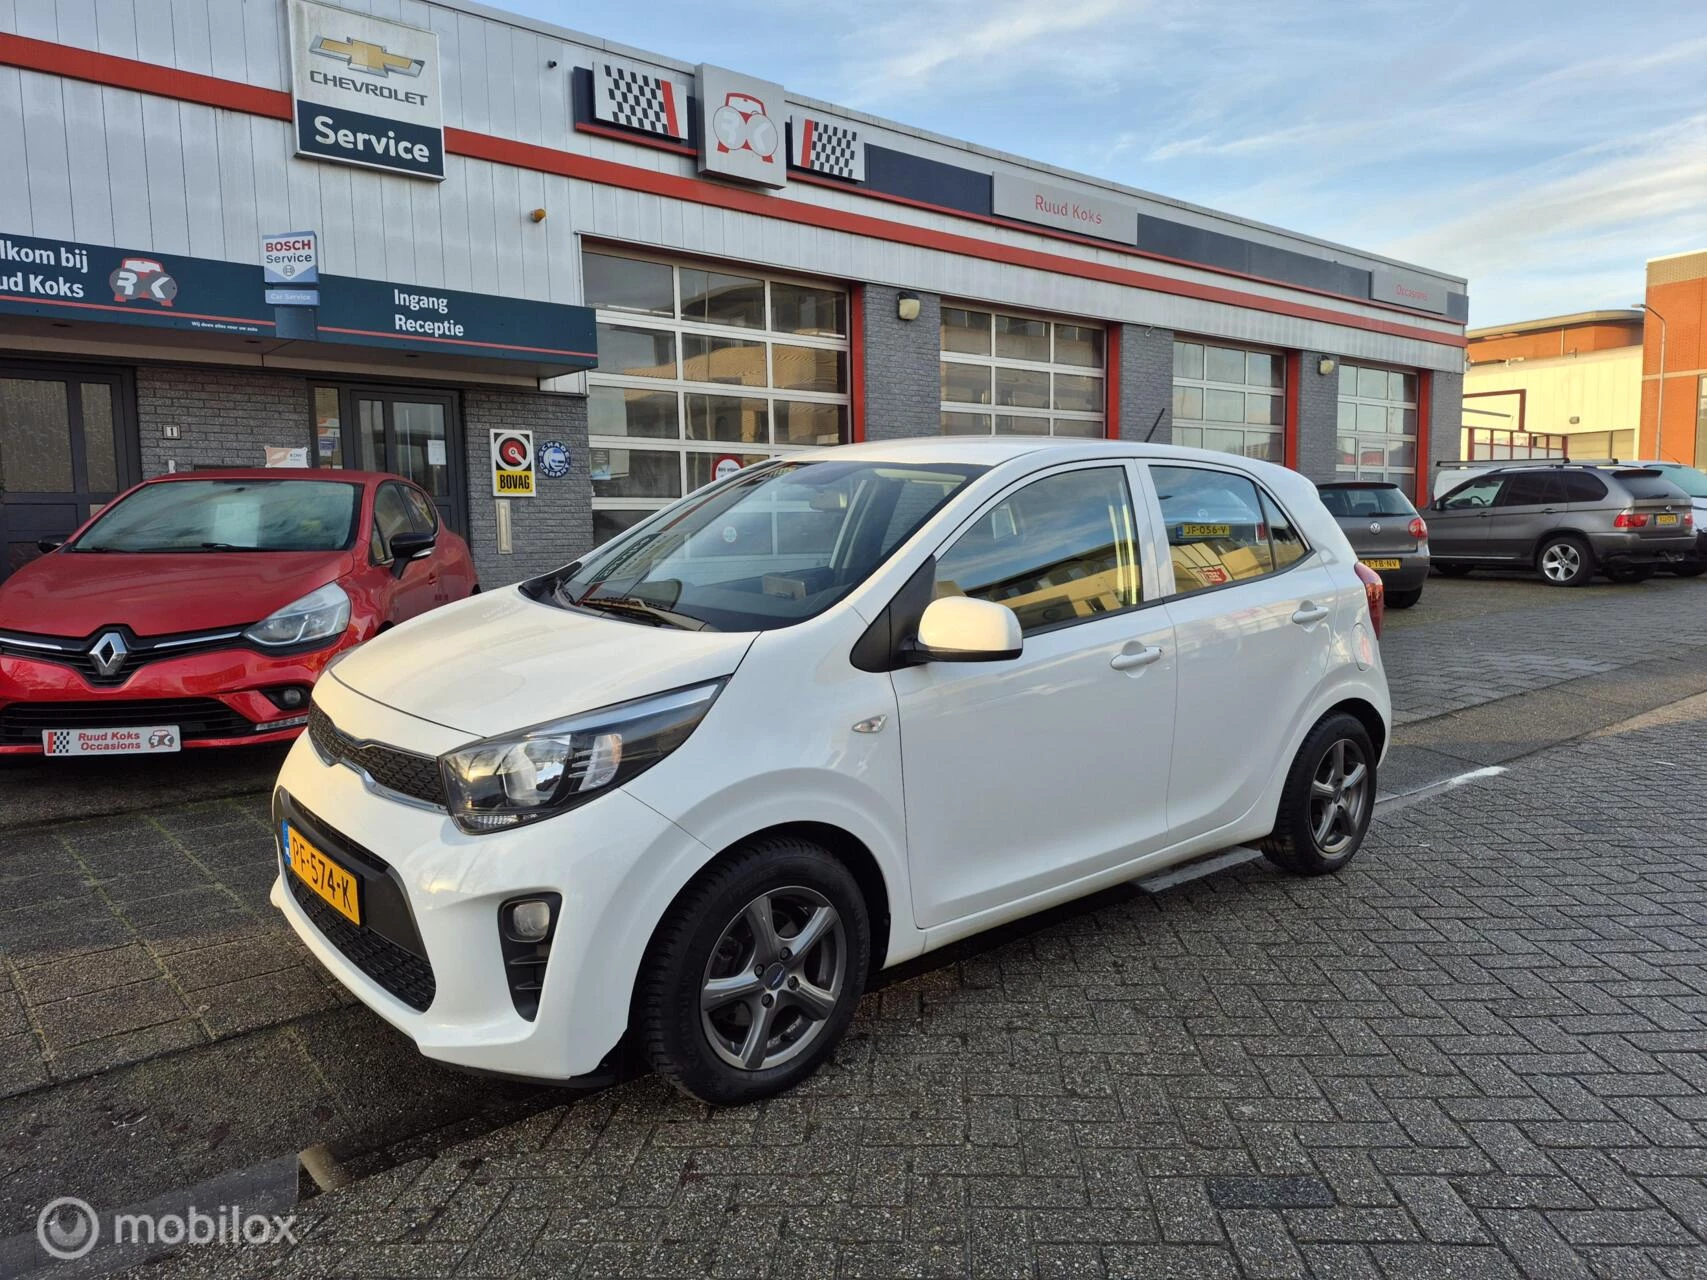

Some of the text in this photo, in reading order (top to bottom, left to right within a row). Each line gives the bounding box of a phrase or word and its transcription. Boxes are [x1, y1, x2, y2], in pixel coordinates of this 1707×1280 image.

[309, 70, 428, 106] CHEVROLET
[313, 115, 430, 163] Service
[1035, 194, 1103, 225] Ruud Koks
[265, 239, 312, 253] BOSCH
[266, 252, 313, 264] Service
[60, 247, 88, 273] bij
[29, 273, 85, 298] Koks
[394, 288, 448, 314] Ingang
[394, 313, 464, 337] Receptie
[499, 474, 530, 490] BOVAG
[78, 731, 141, 742] Ruud Koks
[80, 741, 141, 751] Occasions
[292, 837, 353, 913] PF-574-K
